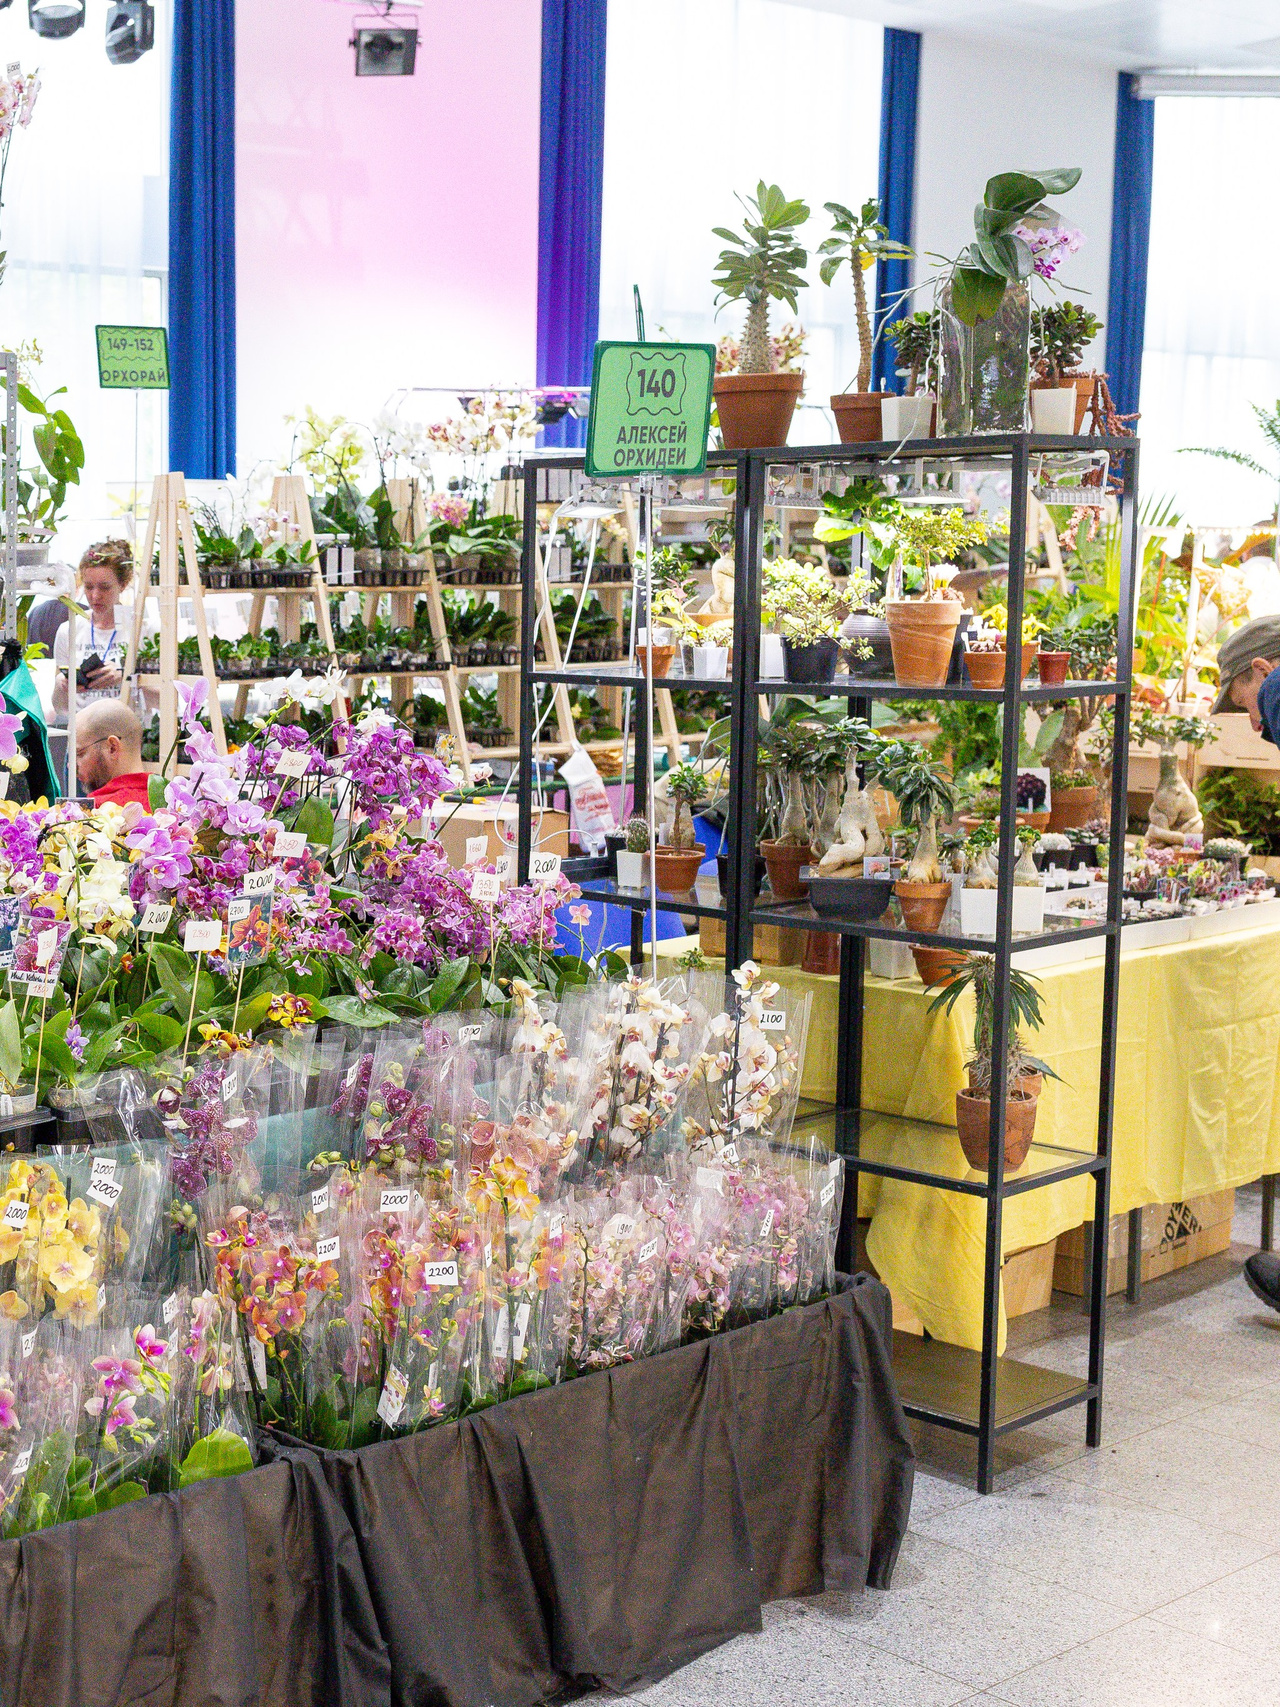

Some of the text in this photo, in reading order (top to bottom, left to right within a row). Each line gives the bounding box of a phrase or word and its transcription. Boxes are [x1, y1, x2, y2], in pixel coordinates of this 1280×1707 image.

[108, 338, 154, 351] 149-152
[101, 368, 166, 382] ОРХОРАЙ
[637, 369, 676, 398] 140
[616, 421, 687, 444] АЛЕКСЕЙ
[535, 857, 557, 875] 2000
[248, 873, 273, 890] 2000
[94, 1163, 114, 1175] 2000
[92, 1179, 120, 1199] 2000
[381, 1194, 408, 1206] 2000
[6, 1206, 27, 1220] 2000
[428, 1265, 455, 1277] 2200
